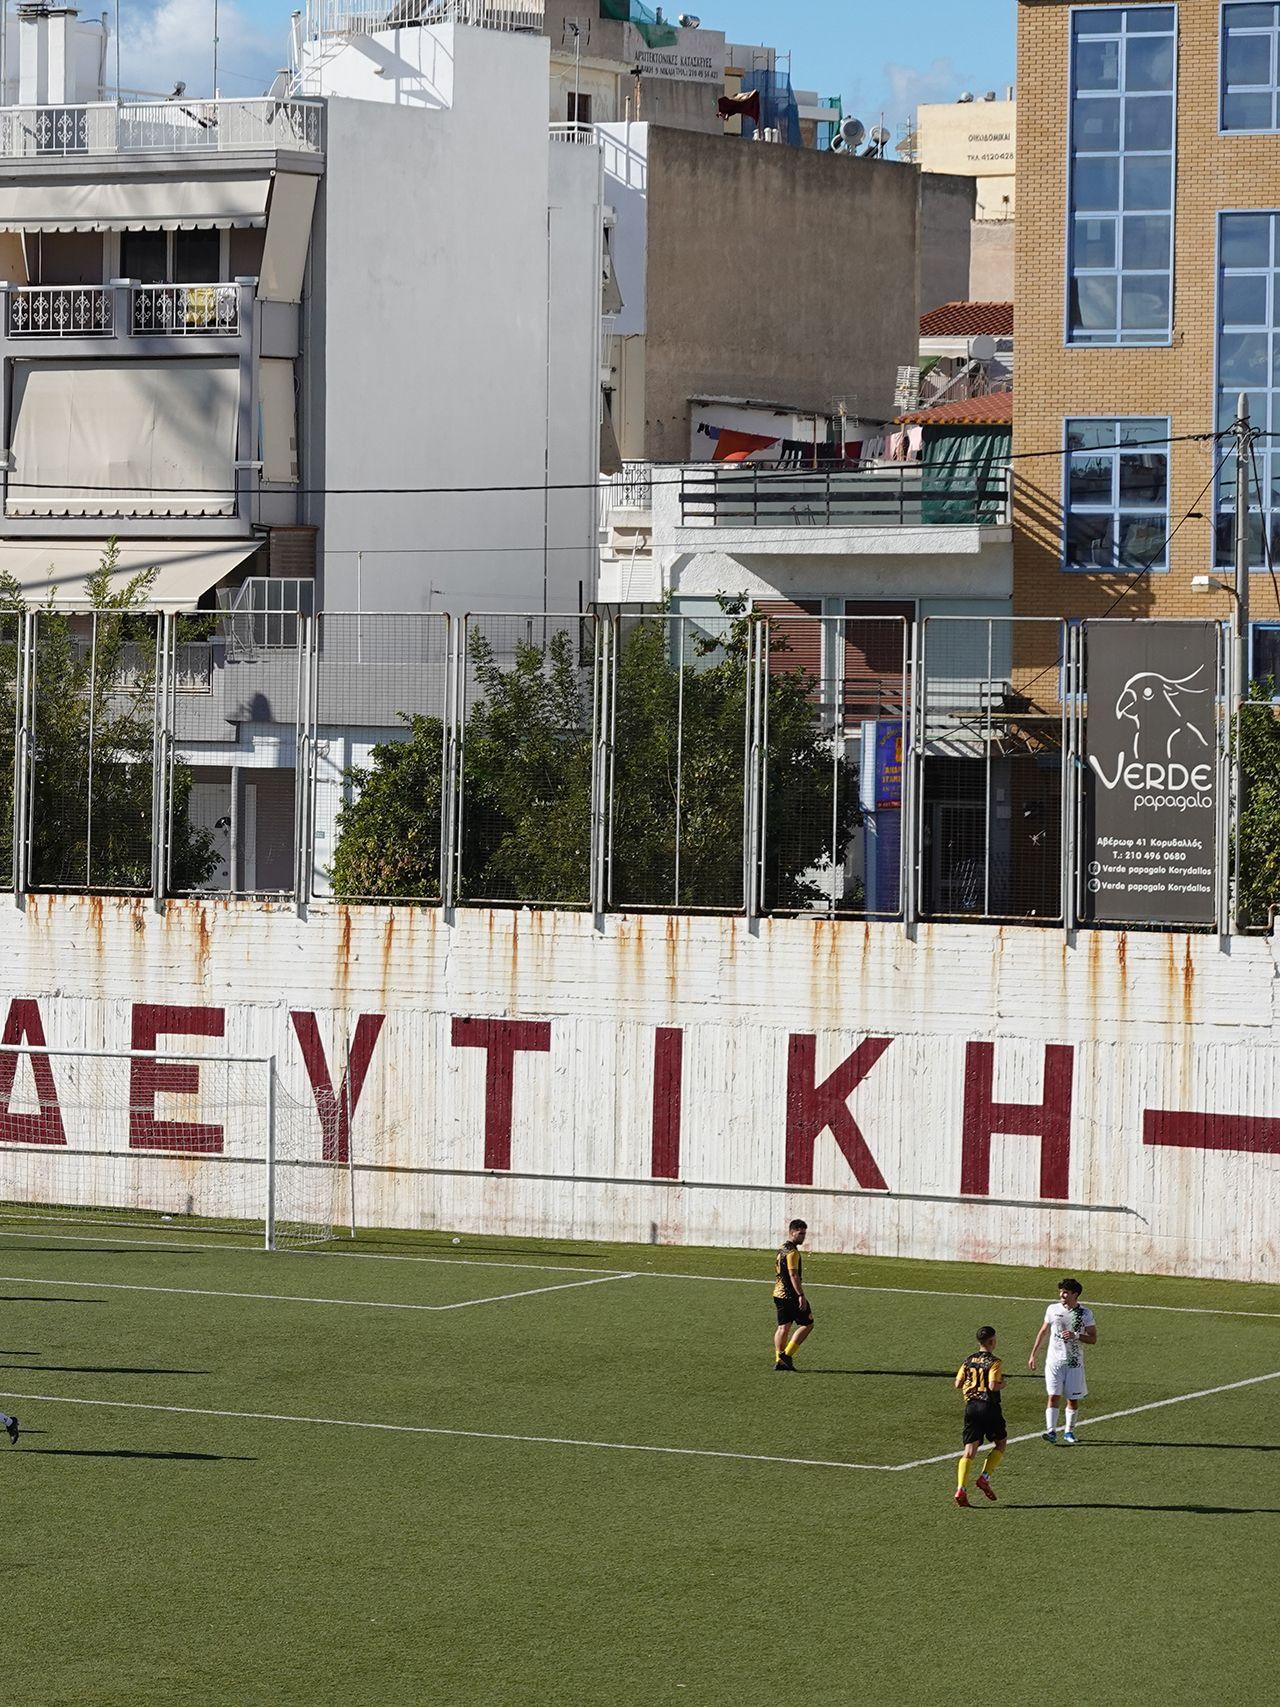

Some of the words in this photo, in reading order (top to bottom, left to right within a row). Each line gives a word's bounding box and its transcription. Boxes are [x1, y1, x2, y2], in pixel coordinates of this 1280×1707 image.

[1089, 751, 1213, 791] VERDE
[1133, 791, 1213, 812] papagalo
[1136, 838, 1146, 846] 41
[1125, 851, 1142, 860] 210
[1143, 851, 1161, 860] 496
[1163, 852, 1187, 861] 0680
[1102, 864, 1126, 873] Verde
[1128, 865, 1167, 876] papagalo
[1168, 866, 1212, 876] Korydallos
[1101, 881, 1126, 890] Verde
[1127, 882, 1166, 893] papagalo
[1167, 883, 1211, 893] Korydallos
